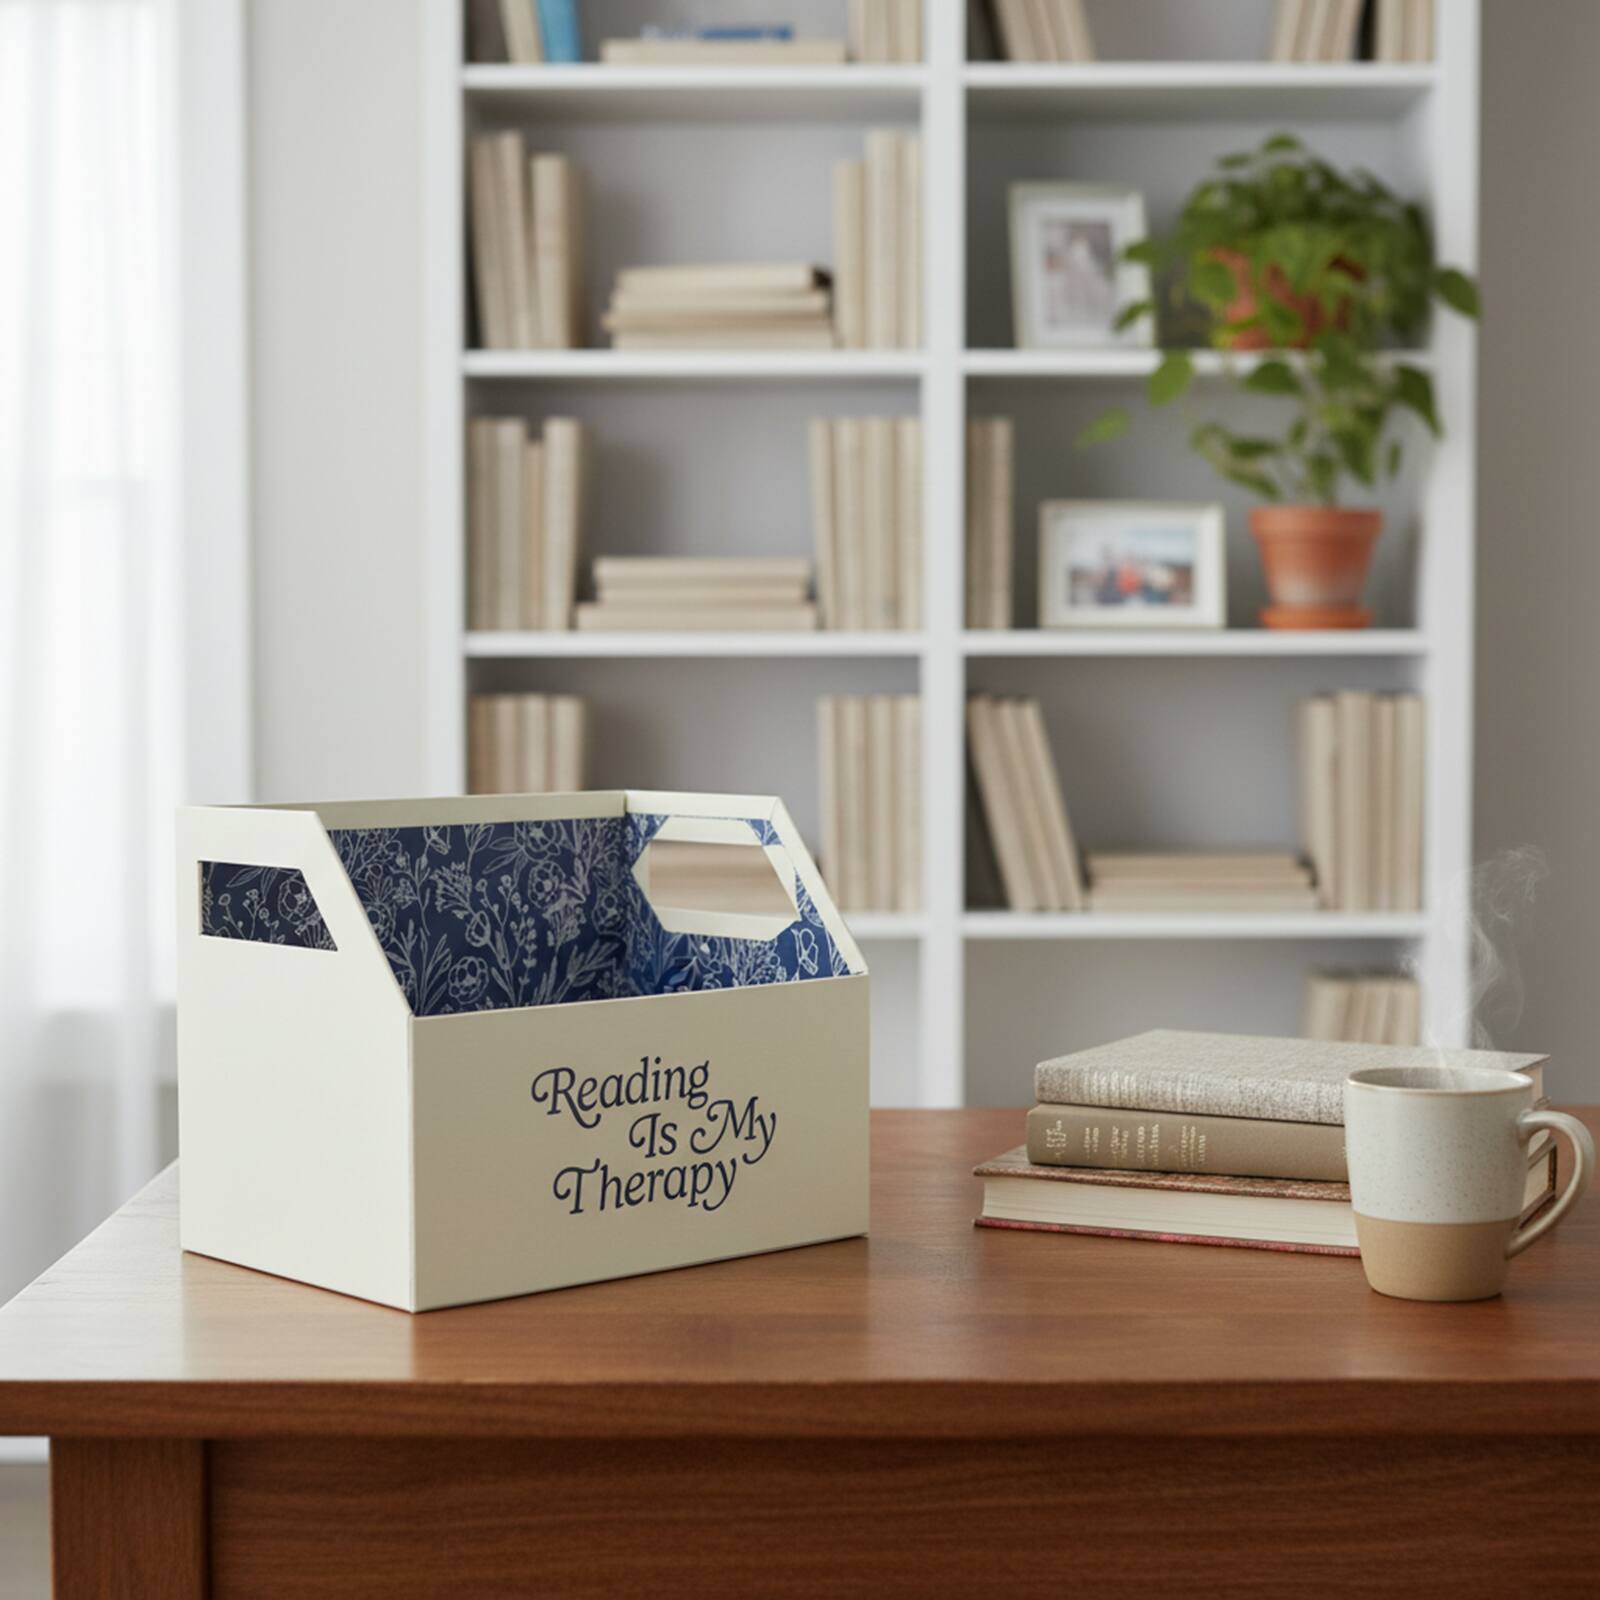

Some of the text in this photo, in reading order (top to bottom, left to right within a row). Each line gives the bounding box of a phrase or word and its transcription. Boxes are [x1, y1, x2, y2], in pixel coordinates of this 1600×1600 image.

[530, 1055, 710, 1129] Reading
[628, 1095, 777, 1166] Is My
[552, 1157, 738, 1216] Therapy
